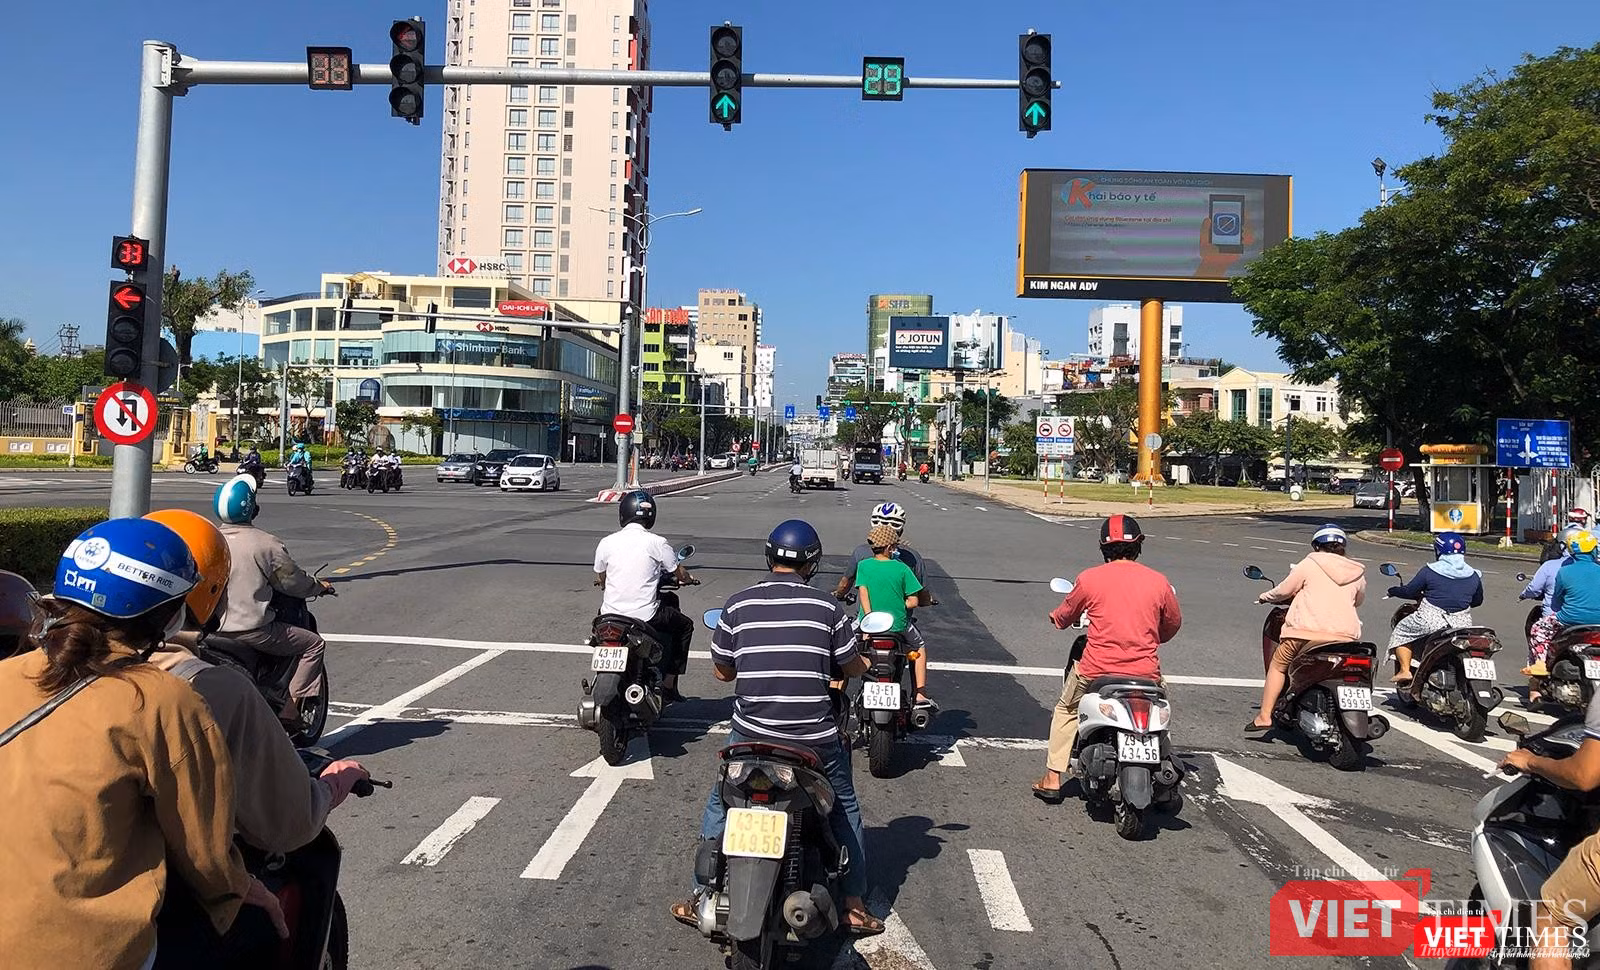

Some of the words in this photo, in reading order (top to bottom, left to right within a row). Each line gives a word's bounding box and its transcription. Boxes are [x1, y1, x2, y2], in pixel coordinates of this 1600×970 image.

[864, 63, 901, 95] 29
[1109, 191, 1131, 201] báo
[1135, 193, 1143, 203] y
[1144, 190, 1156, 201] tế
[121, 242, 142, 264] 33
[480, 262, 506, 271] HSBC
[1030, 280, 1048, 290] KIM
[1050, 281, 1077, 290] NGAN
[1079, 281, 1098, 291] ADV
[908, 333, 940, 343] JOTUN
[456, 342, 496, 353] Shinhan
[502, 345, 525, 355] Bank
[117, 562, 156, 581] BETTER
[157, 576, 174, 589] RIDE
[598, 648, 622, 658] 43-H1
[593, 659, 625, 670] 039.02
[870, 684, 894, 696] 43-E1
[1343, 688, 1365, 698] 43-E1
[866, 695, 897, 707] 554.04
[1121, 747, 1158, 761] 434.56
[736, 812, 776, 833] 43-E1
[730, 833, 781, 855] 149.56
